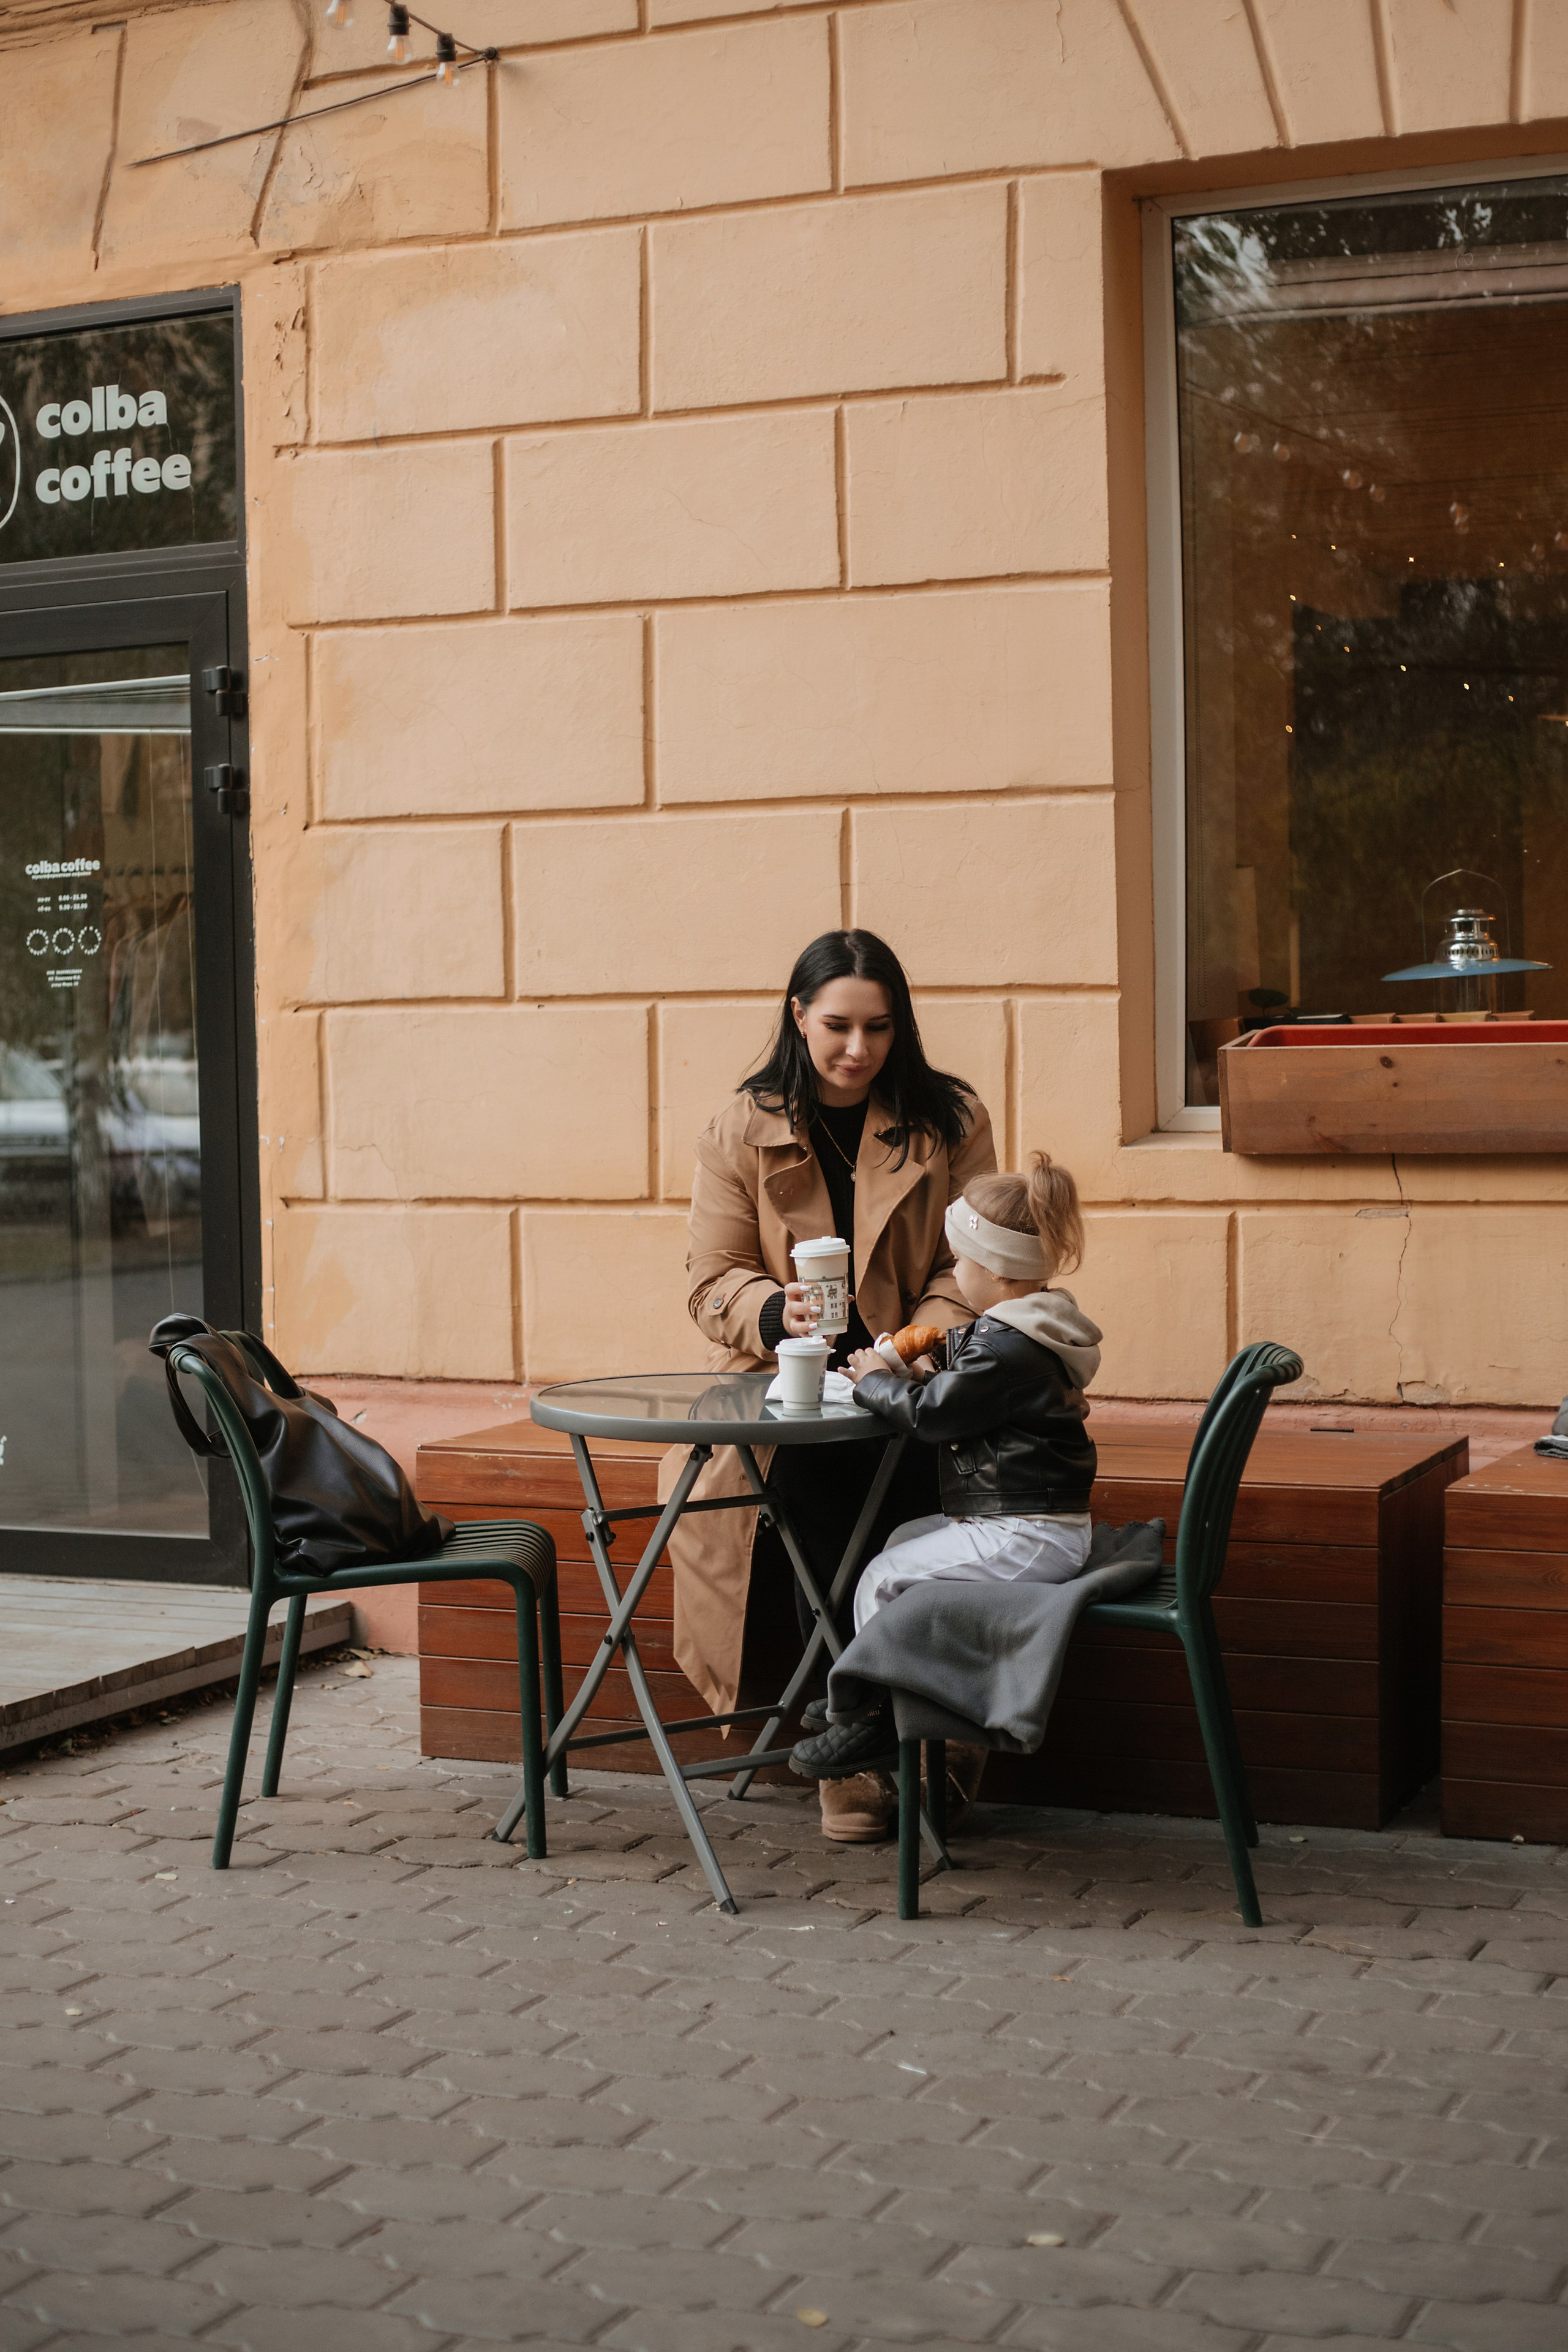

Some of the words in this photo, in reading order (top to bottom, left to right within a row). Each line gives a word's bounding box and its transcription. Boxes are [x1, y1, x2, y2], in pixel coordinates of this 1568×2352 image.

[36, 384, 167, 439] colba
[36, 447, 192, 503] coffee
[25, 860, 60, 875] colba
[61, 858, 100, 873] coffee
